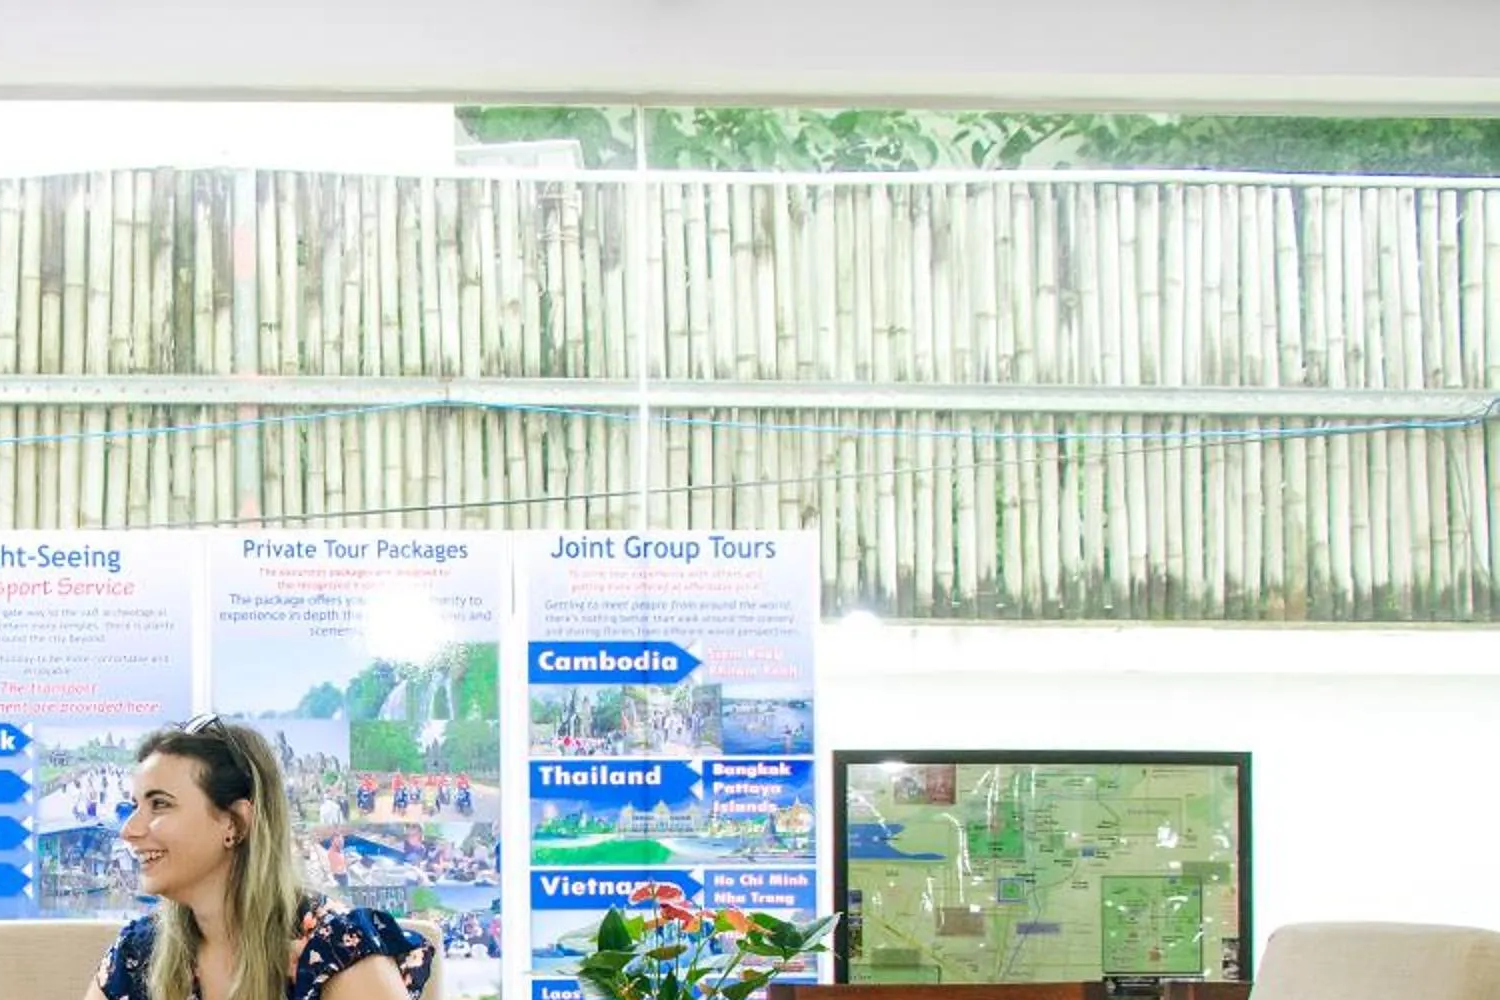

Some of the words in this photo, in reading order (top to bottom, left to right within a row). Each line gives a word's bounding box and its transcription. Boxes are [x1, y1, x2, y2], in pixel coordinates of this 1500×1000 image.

[243, 539, 317, 559] Private
[323, 539, 370, 559] Tour
[377, 539, 468, 563] Packages
[550, 536, 615, 559] Joint
[624, 536, 700, 564] Group
[708, 536, 777, 559] Tours
[58, 577, 135, 596] Service
[229, 594, 252, 605] The
[255, 594, 304, 608] package
[468, 595, 484, 606] to
[219, 611, 287, 624] experience
[303, 609, 339, 623] depth
[538, 650, 679, 671] Cambodia
[539, 766, 662, 785] Thailand
[712, 763, 791, 778] Bangkok
[712, 782, 783, 798] Pattaya
[540, 876, 642, 896] Vietna
[713, 874, 735, 886] Ho
[740, 874, 764, 886] Chi
[769, 874, 808, 886] Minh
[750, 892, 795, 906] Trang
[542, 987, 581, 1000] Laos
